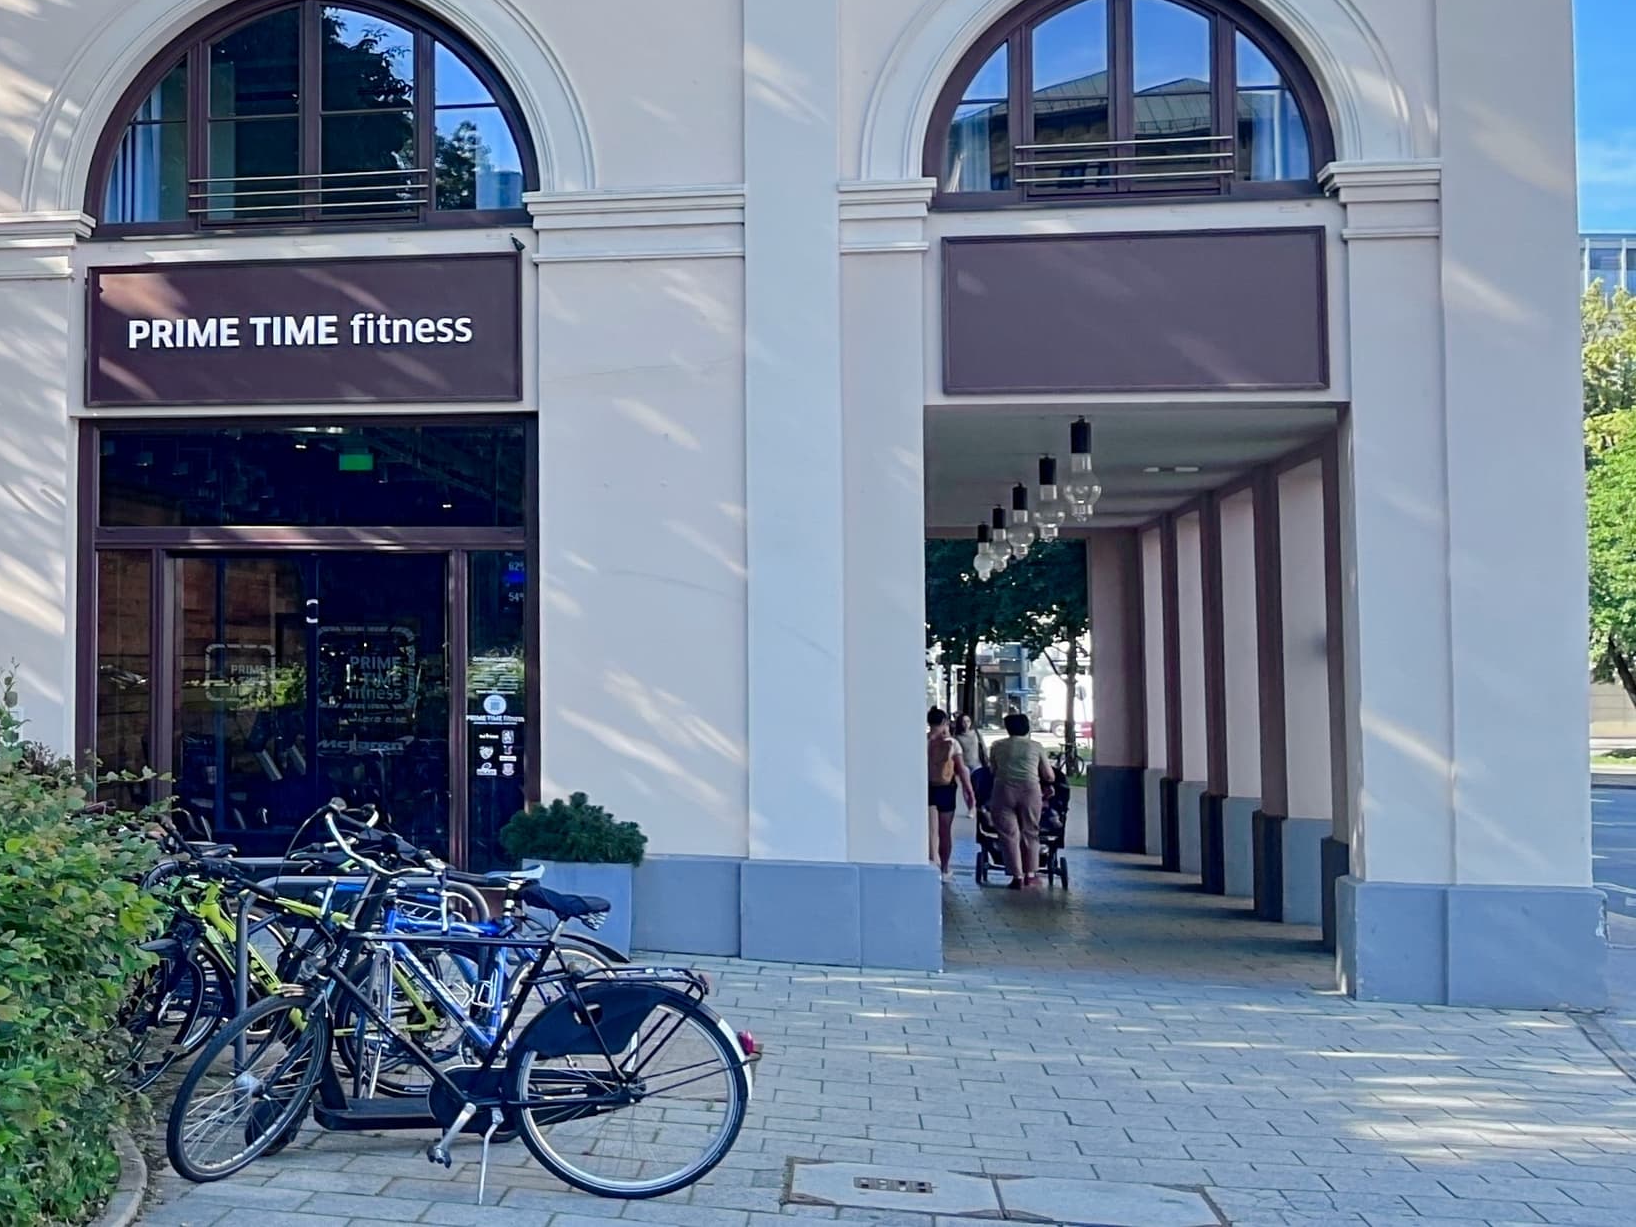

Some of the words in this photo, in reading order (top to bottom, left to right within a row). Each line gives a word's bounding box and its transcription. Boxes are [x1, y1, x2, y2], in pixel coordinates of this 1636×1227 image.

[128, 318, 240, 349] PRIME
[249, 315, 339, 346] TIME
[350, 313, 473, 345] fitness
[349, 655, 402, 670] PRIME
[348, 684, 403, 700] fitness
